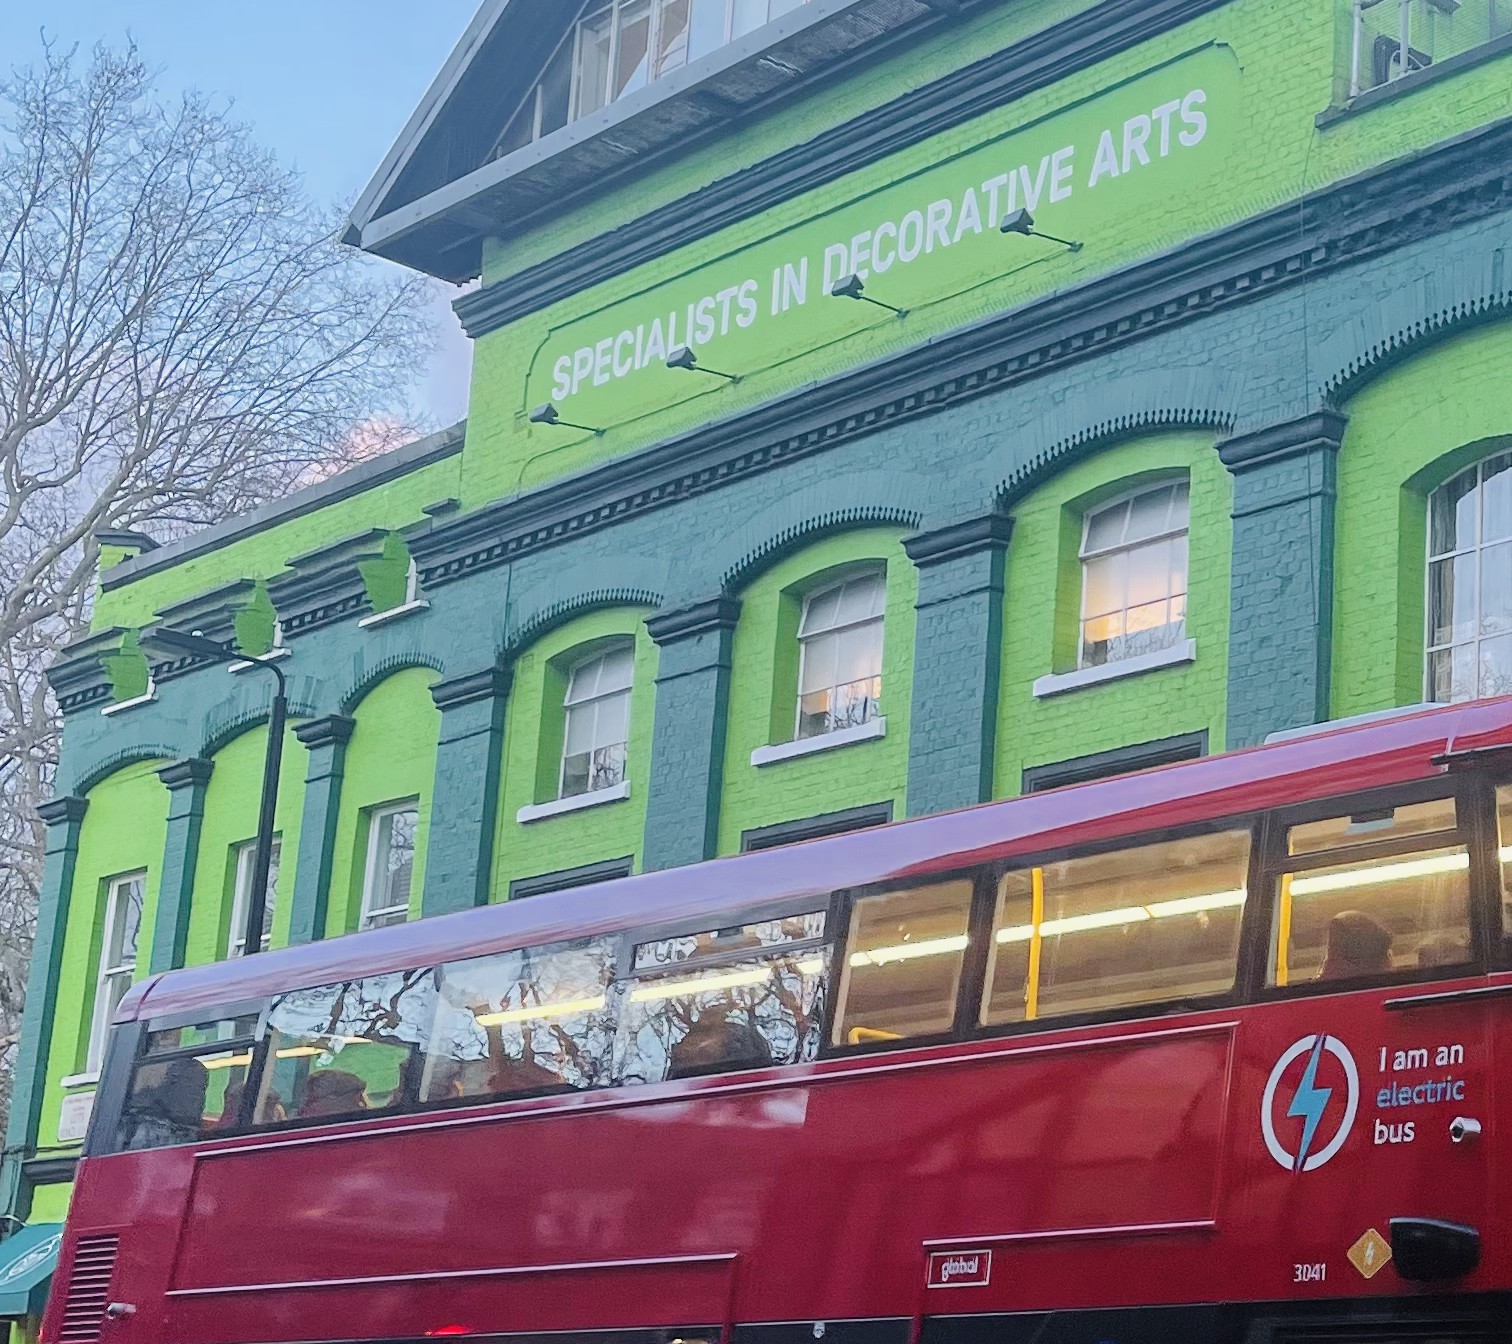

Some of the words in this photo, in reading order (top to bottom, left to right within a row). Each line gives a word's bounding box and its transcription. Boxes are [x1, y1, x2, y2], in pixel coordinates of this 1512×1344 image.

[552, 279, 758, 400] SPECIALISTS
[771, 257, 808, 315] IN
[822, 145, 1075, 297] DECORATIVE
[1088, 88, 1208, 187] ARTS
[1379, 1046, 1387, 1072] I
[1393, 1048, 1428, 1071] am
[1435, 1043, 1464, 1066] an
[1377, 1075, 1466, 1108] electric
[1374, 1118, 1416, 1145] bus
[941, 1255, 979, 1282] global
[1293, 1262, 1327, 1283] 3041
